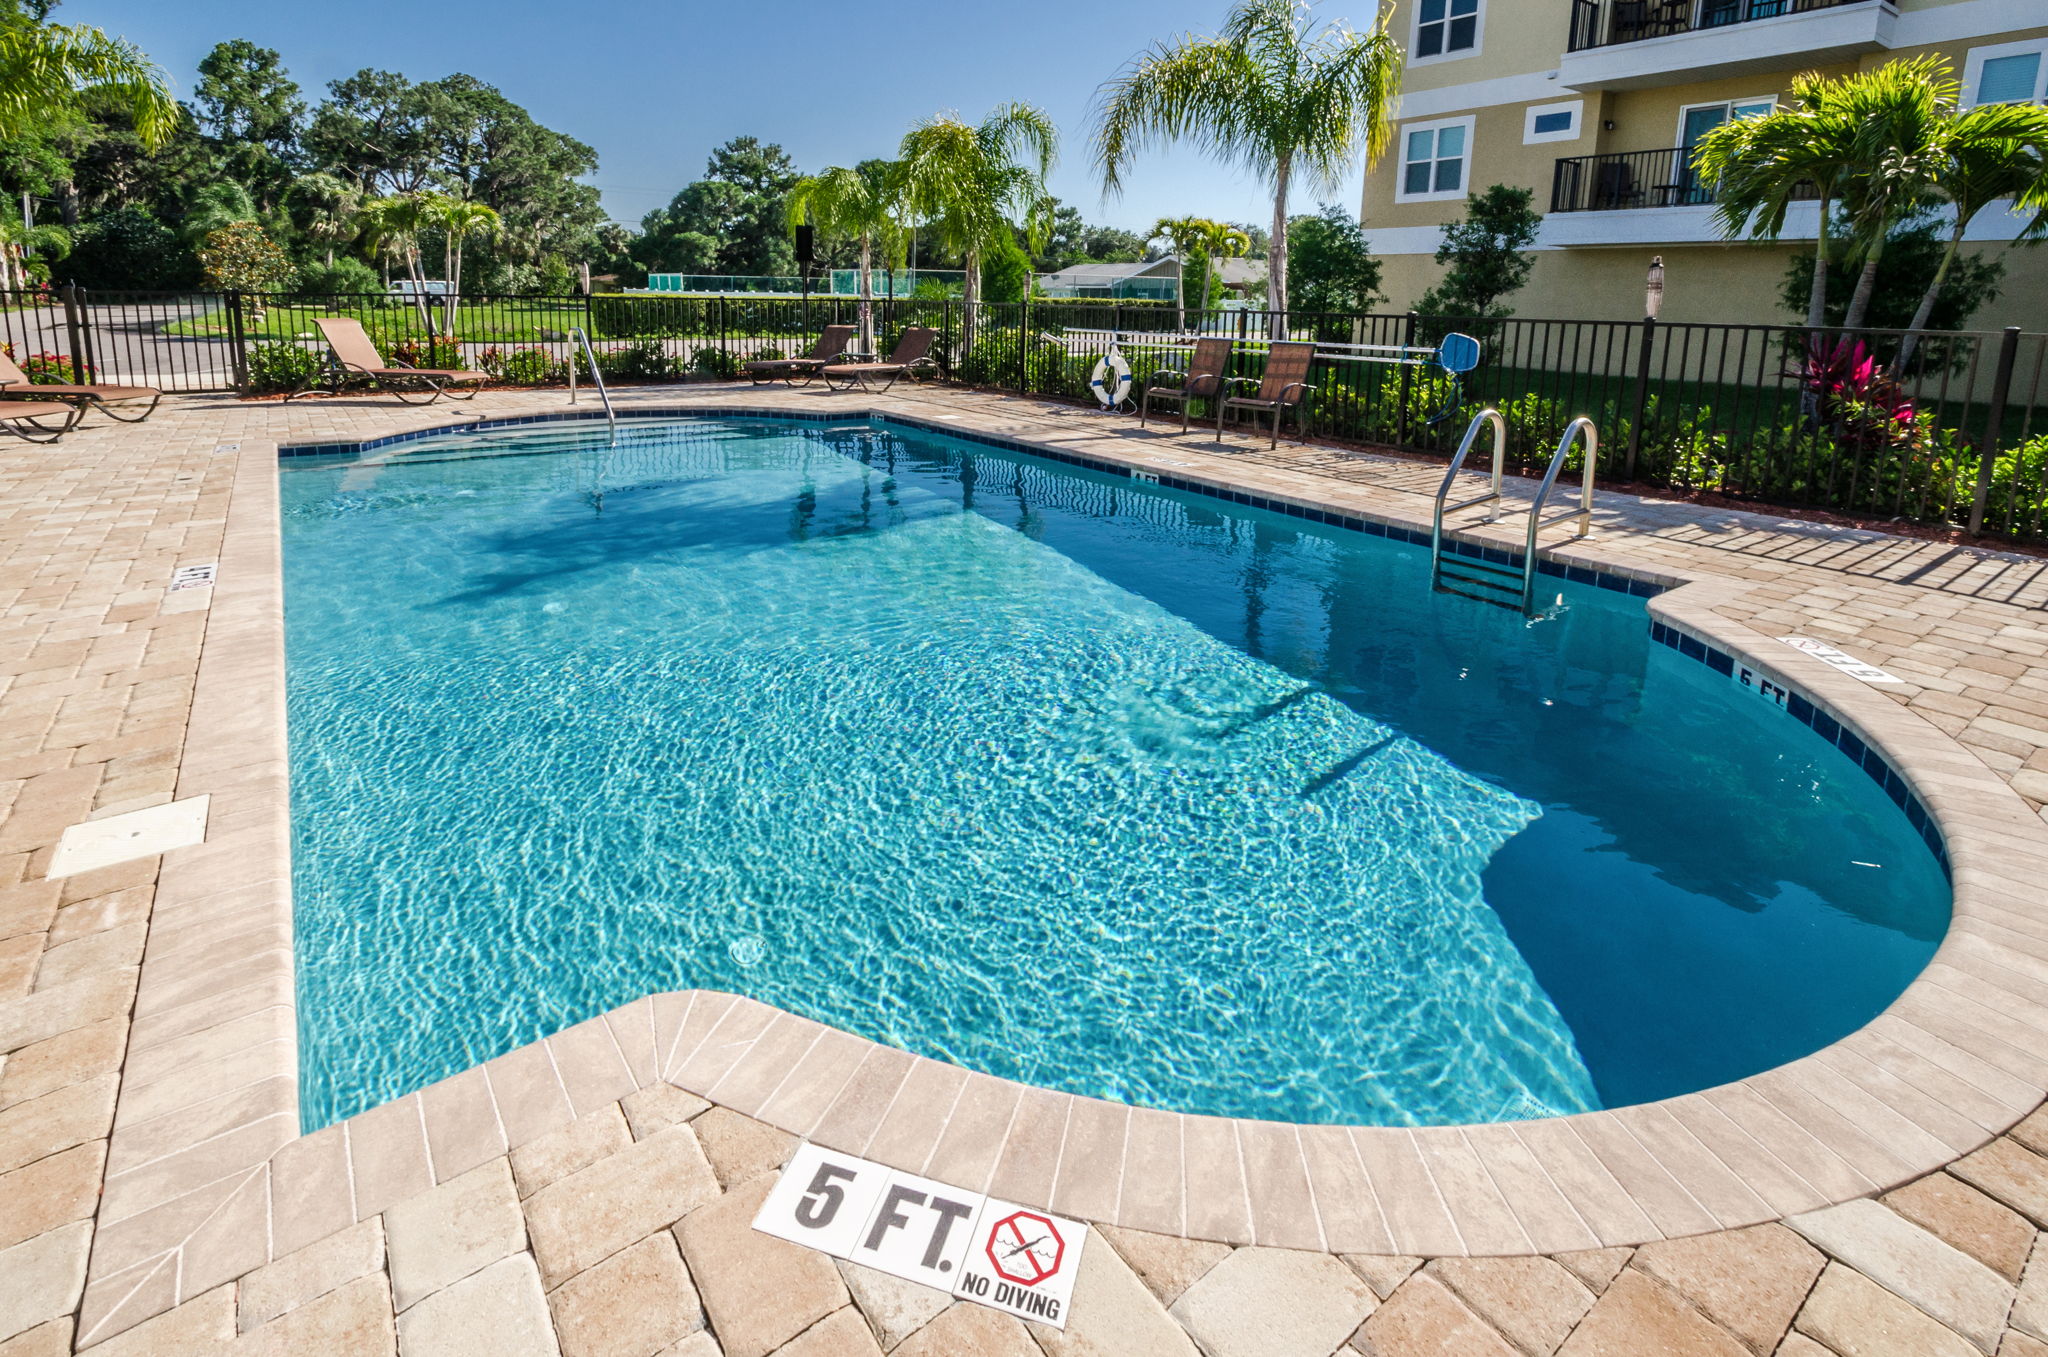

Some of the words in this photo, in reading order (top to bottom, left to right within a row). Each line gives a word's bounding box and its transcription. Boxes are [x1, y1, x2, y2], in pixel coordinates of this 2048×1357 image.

[1145, 474, 1157, 483] FT
[1740, 667, 1752, 686] 5
[1760, 679, 1786, 706] FT
[1848, 669, 1885, 677] 5
[794, 1162, 858, 1229] 5
[863, 1184, 973, 1273] FT.
[961, 1272, 990, 1297] NO
[994, 1282, 1061, 1321] DIVING
